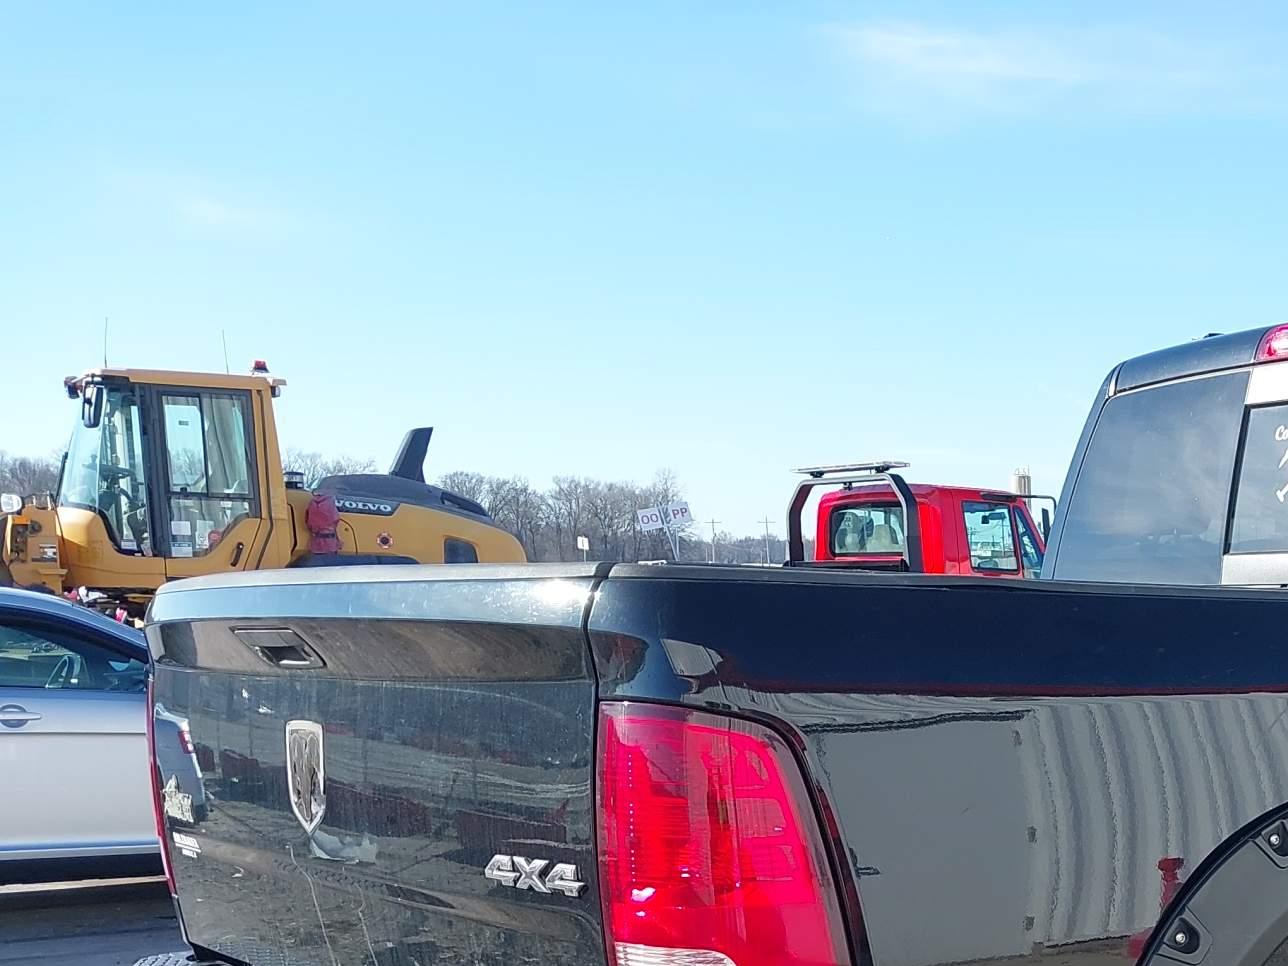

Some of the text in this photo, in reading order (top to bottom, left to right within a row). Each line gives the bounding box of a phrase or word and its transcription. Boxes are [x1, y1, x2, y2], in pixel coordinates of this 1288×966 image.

[335, 499, 392, 512] VOLVO
[640, 513, 659, 524] OO
[671, 507, 688, 519] PP
